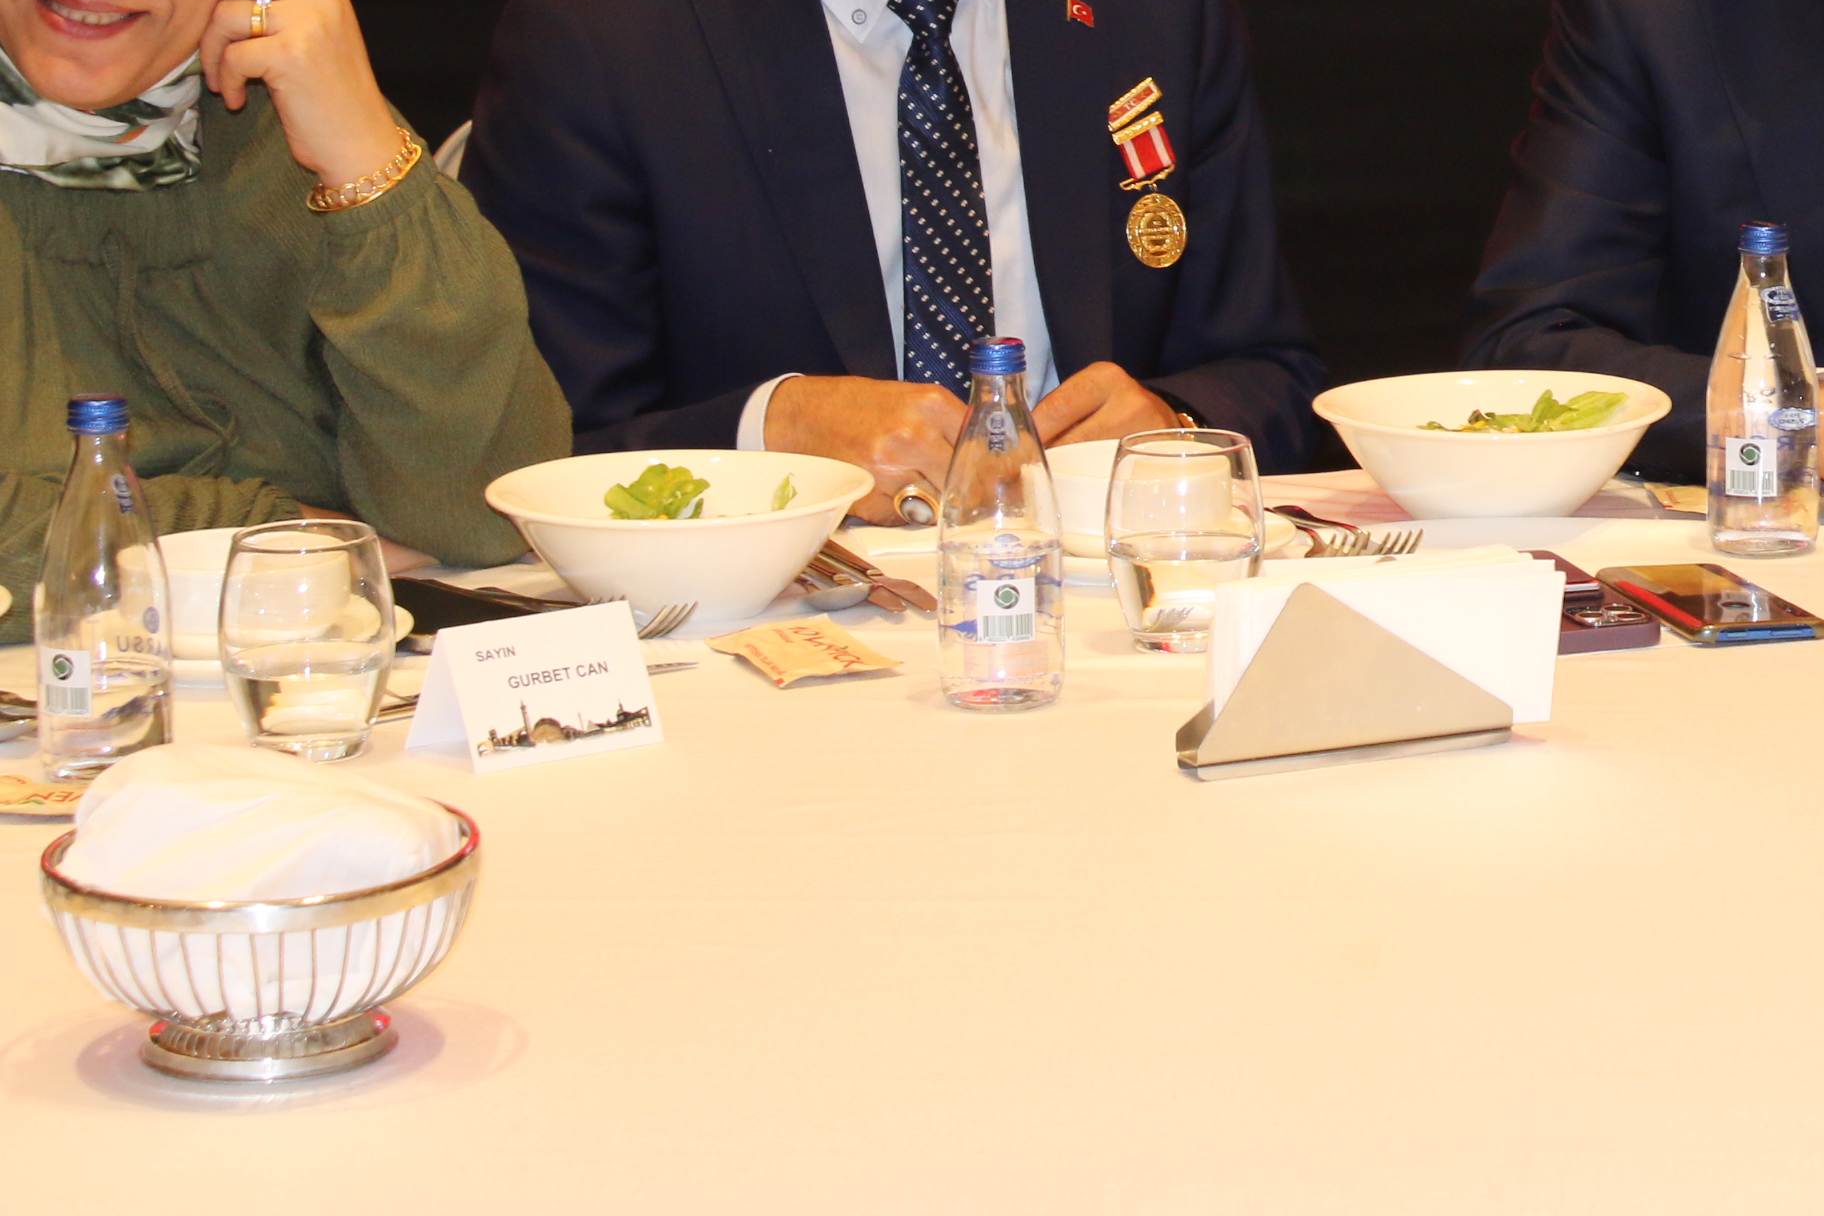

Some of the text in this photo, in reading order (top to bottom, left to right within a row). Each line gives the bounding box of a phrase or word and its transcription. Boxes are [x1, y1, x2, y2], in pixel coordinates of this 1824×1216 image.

[475, 645, 516, 662] SAYIN
[507, 660, 609, 689] GURBET CAN
